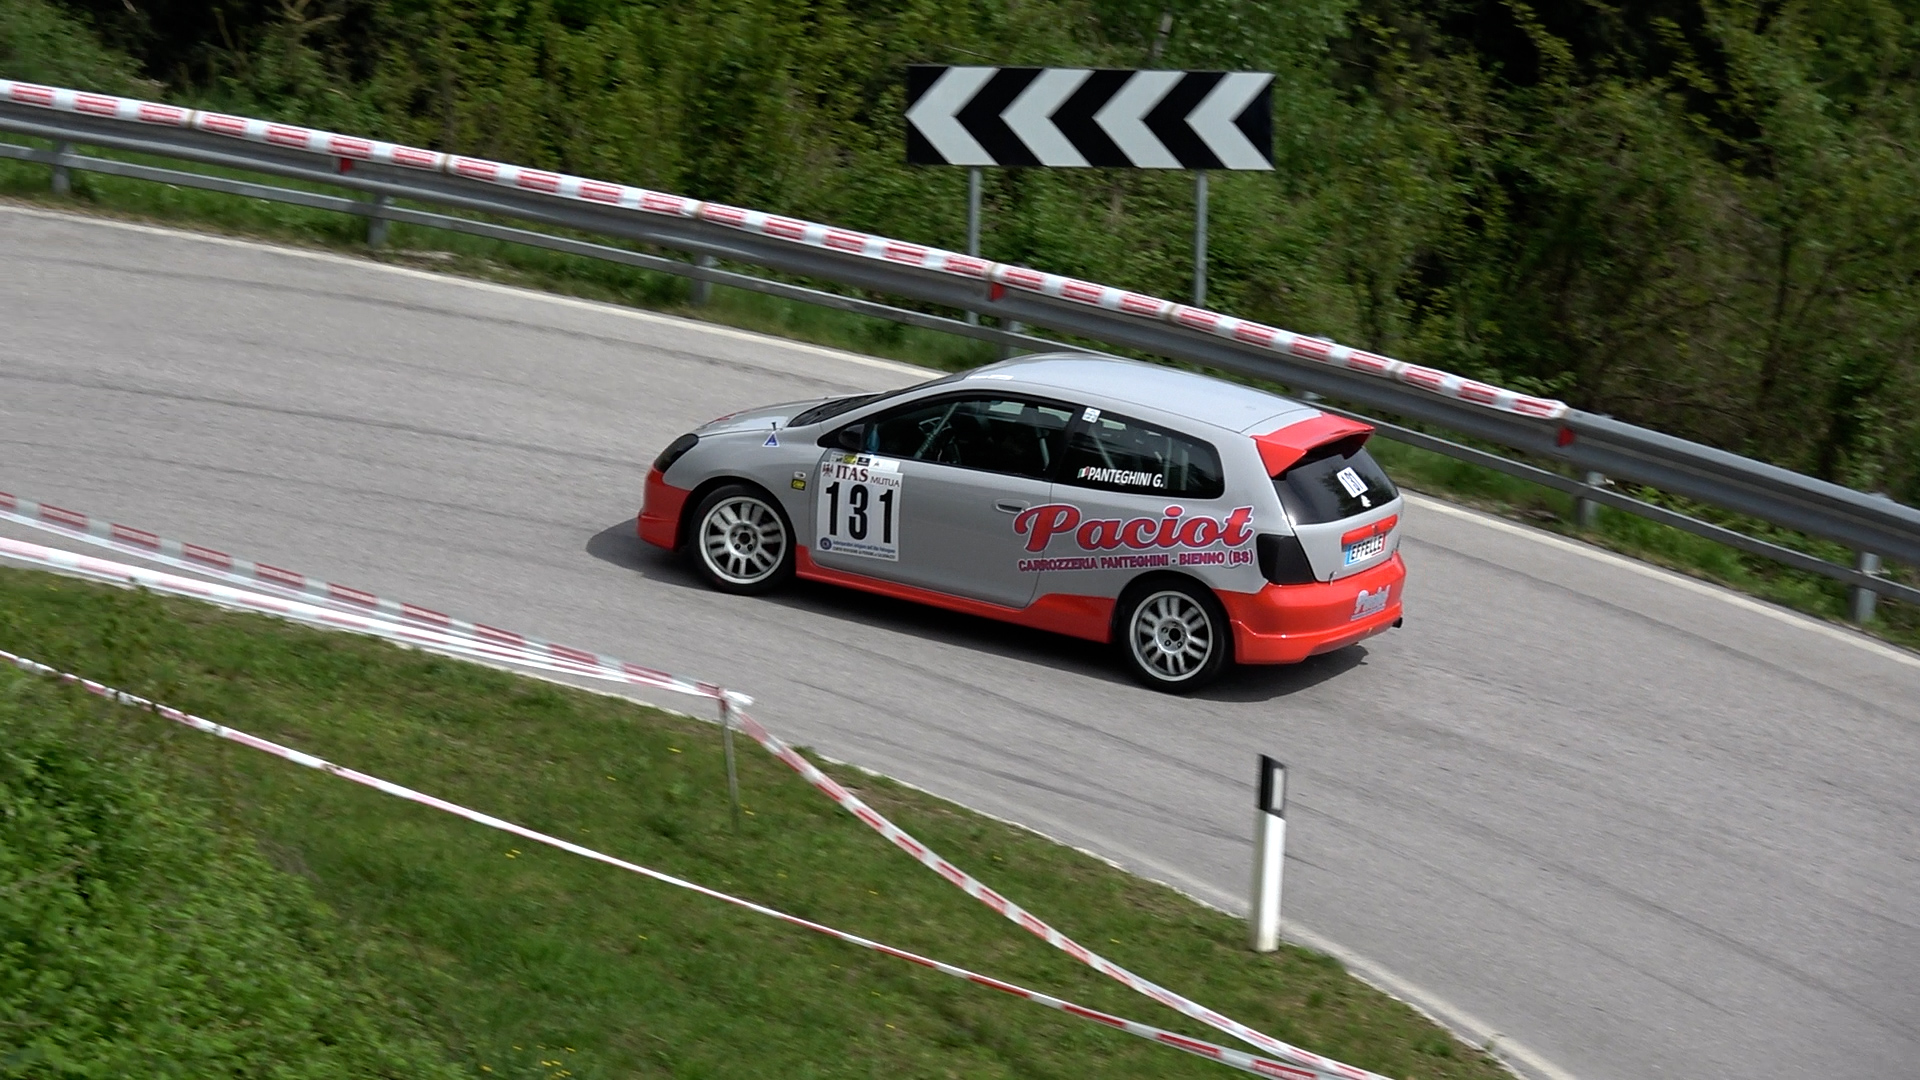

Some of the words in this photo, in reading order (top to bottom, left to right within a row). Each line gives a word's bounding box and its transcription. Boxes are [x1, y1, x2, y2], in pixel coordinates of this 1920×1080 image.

[836, 465, 868, 482] ITAS
[870, 476, 899, 487] MUTUA
[1088, 467, 1152, 486] PANTEGHINI
[1153, 473, 1164, 488] G.
[825, 481, 894, 544] 131
[1014, 504, 1254, 552] Paciot
[1352, 535, 1383, 560] EFFELLE
[1018, 558, 1097, 572] CARROZZERIA
[1101, 554, 1169, 569] PANTEGHINI
[1179, 552, 1225, 566] BIENNO
[1228, 549, 1254, 566] (BS)
